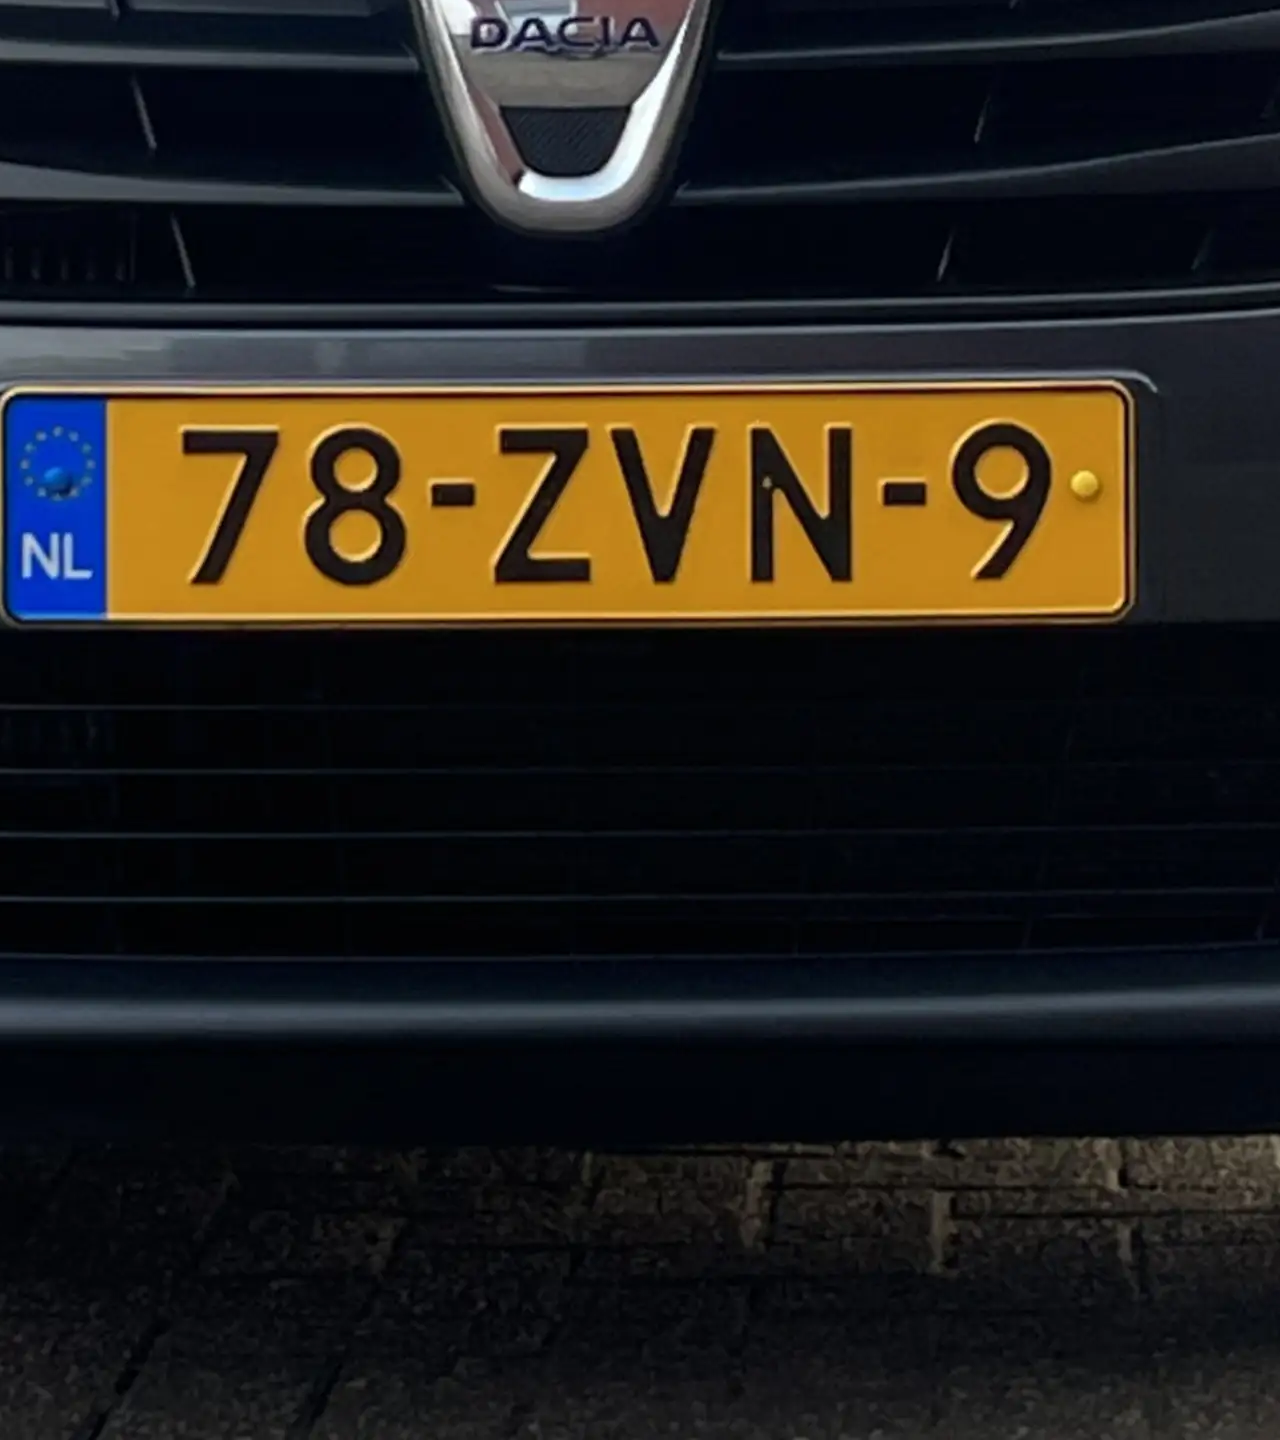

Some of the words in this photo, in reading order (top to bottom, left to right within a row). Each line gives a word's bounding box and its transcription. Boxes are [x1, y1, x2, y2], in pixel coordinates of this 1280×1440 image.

[470, 16, 660, 49] DACIA
[180, 422, 1052, 585] 78-ZVN-9
[21, 531, 94, 580] NL
